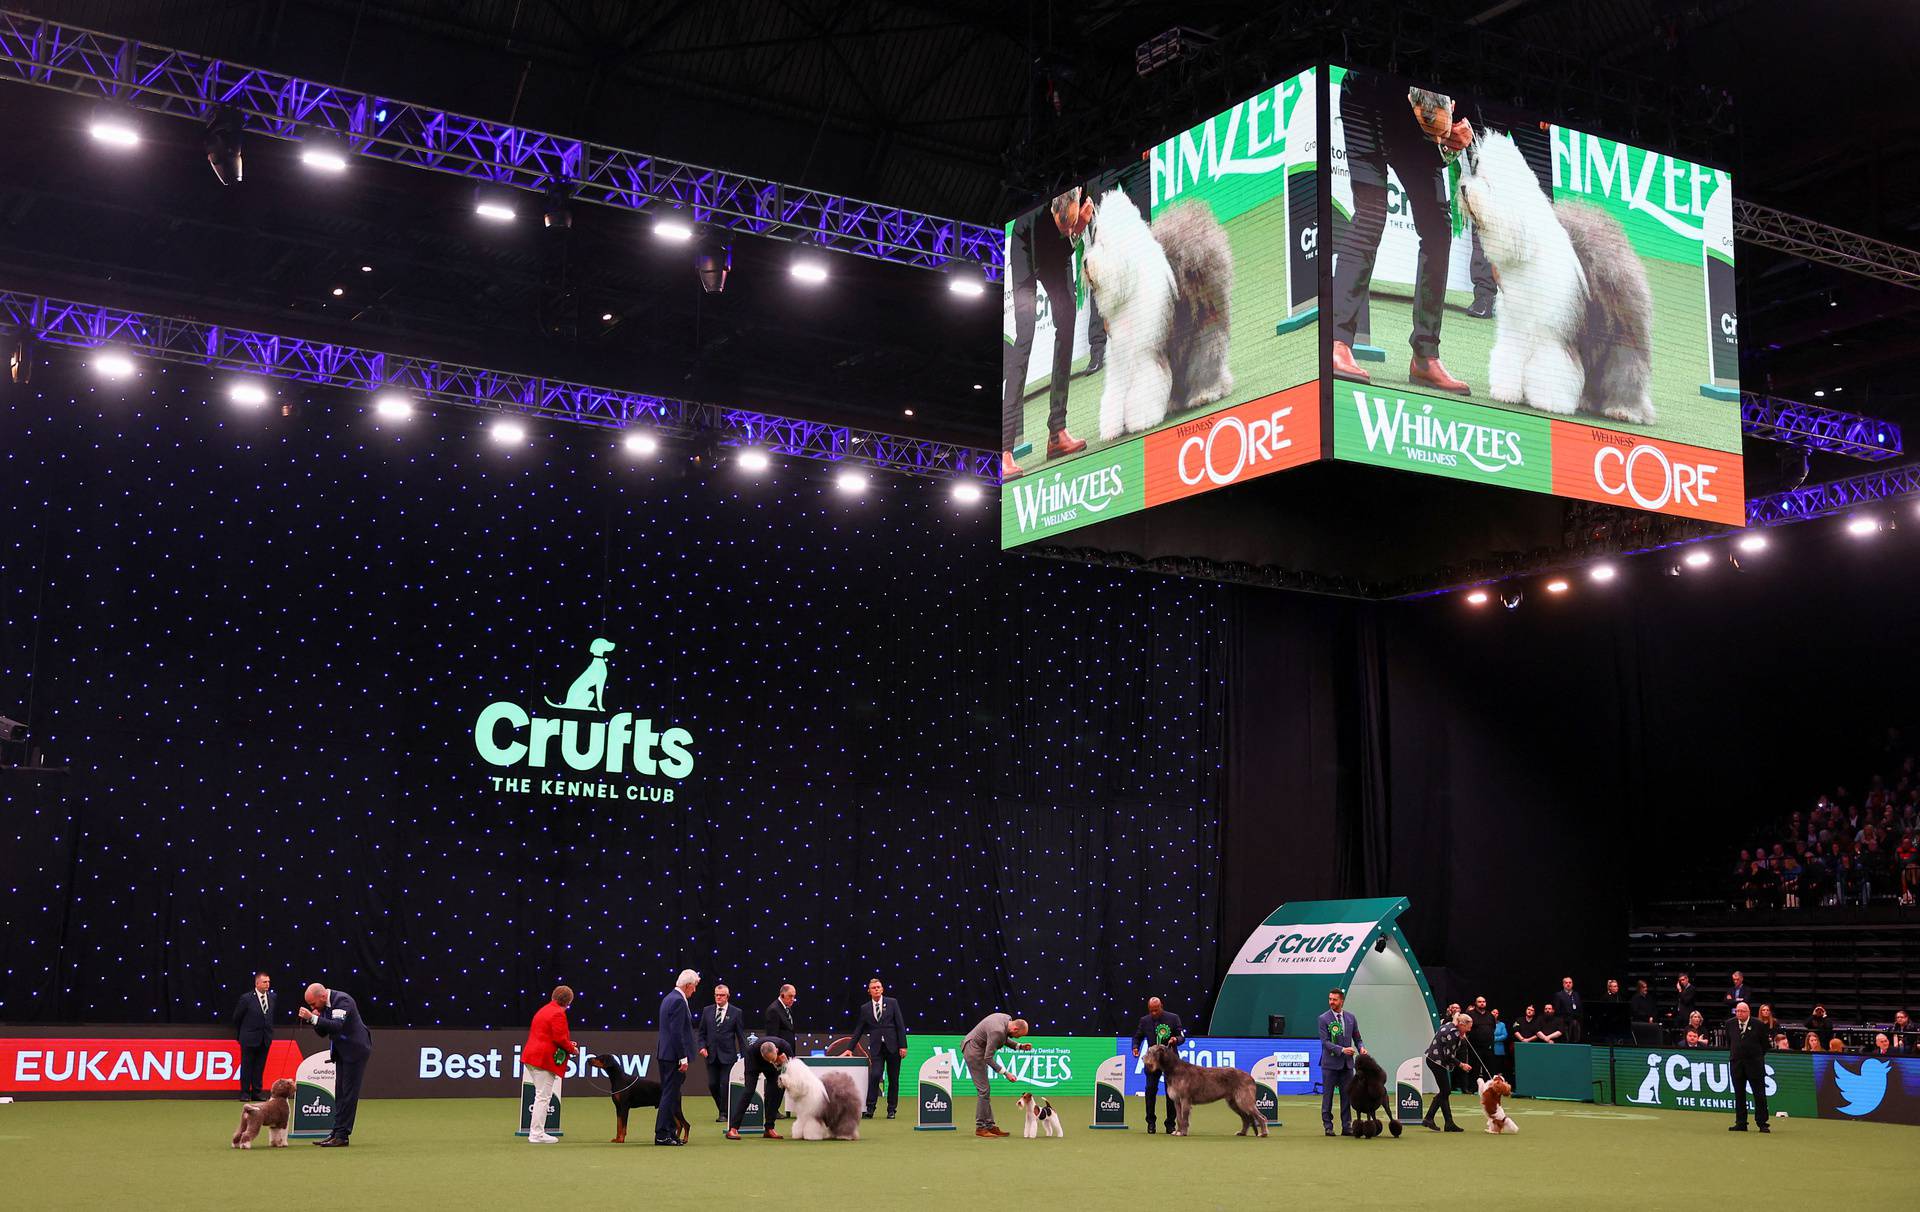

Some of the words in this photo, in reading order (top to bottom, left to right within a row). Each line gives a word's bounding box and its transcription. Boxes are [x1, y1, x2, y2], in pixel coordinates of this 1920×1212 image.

[1176, 417, 1215, 438] WELLNESS
[1178, 406, 1293, 485] CORE
[1592, 430, 1636, 448] WELLNESS
[1594, 444, 1719, 510] CORE
[474, 701, 695, 779] Crufts
[492, 777, 531, 793] THE
[541, 780, 619, 798] KENNEL
[626, 785, 675, 802] CLUB
[1279, 932, 1354, 954] Crufts
[419, 1047, 502, 1078] Best
[513, 1045, 525, 1078] i
[1665, 1053, 1777, 1097] Crus
[302, 1104, 331, 1114] Crufts
[925, 1101, 948, 1109] Crufts
[1100, 1101, 1121, 1109] Crufts
[1256, 1099, 1275, 1108] Crufts
[1401, 1099, 1420, 1107] Crufts
[1676, 1096, 1695, 1106] THE
